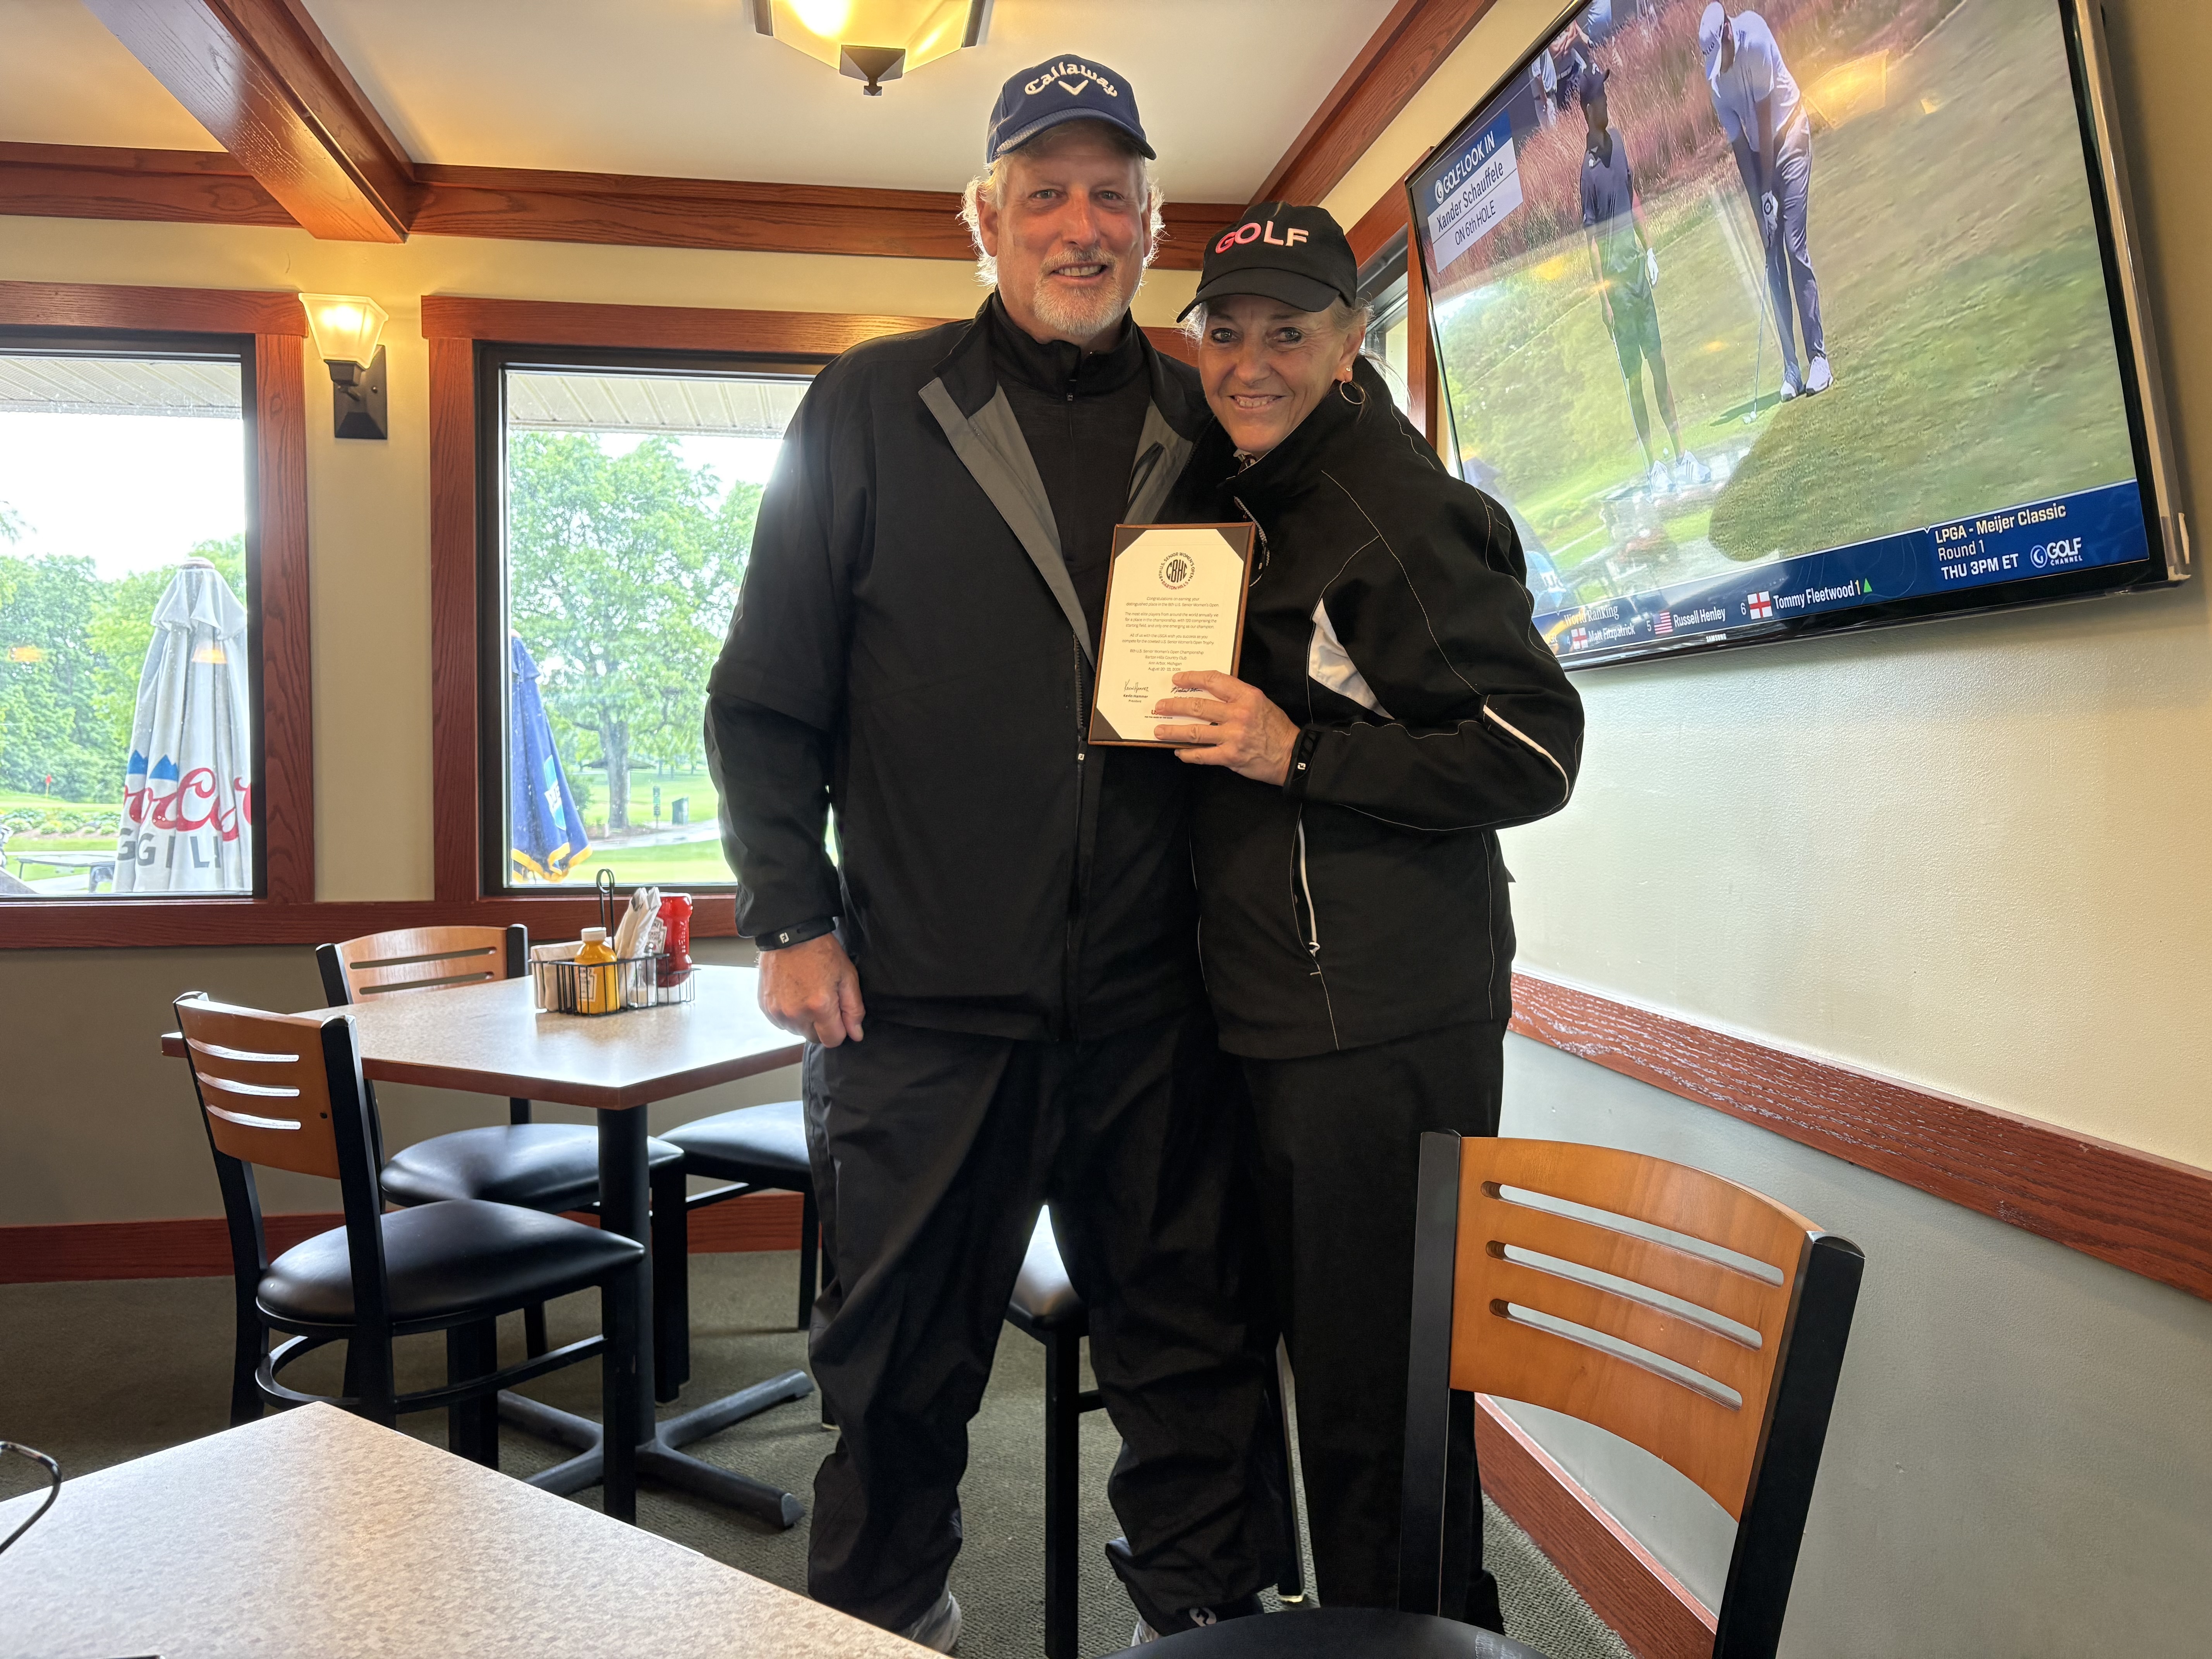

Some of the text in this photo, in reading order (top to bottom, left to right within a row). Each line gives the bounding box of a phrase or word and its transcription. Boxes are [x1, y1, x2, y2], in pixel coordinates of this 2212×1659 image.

[1025, 62, 1117, 97] Callaway
[1443, 130, 1495, 194] GOLF LOOK IN
[1437, 161, 1503, 232] Xander Schauffele
[1455, 200, 1496, 245] ON 6th HOLE
[1215, 220, 1309, 254] GOLF
[1935, 525, 1967, 544] LPGA
[1976, 515, 2015, 534] Meijer
[2018, 503, 2066, 526] Classic
[1164, 552, 1178, 562] SENIOR
[1180, 552, 1194, 566] WOMEN'S
[1938, 539, 1984, 561] Round 1
[2047, 537, 2082, 559] GOLF
[2050, 555, 2083, 566] CHANNEL
[1941, 553, 2019, 580] THU 3PM ET
[1162, 581, 1177, 590] BARTON
[1564, 605, 1619, 627] World Ranking
[1588, 629, 1603, 642] Matt
[1603, 623, 1636, 641] Fitzpatrick
[1646, 620, 1652, 632] 5
[1673, 610, 1698, 627] Russell
[1700, 606, 1726, 622] Henley
[1740, 602, 1747, 615] 6
[1773, 593, 1805, 610] Tommy
[1806, 580, 1855, 604] Fleetwood
[1855, 579, 1861, 595] 1
[1706, 633, 1727, 643] SAMSUNG
